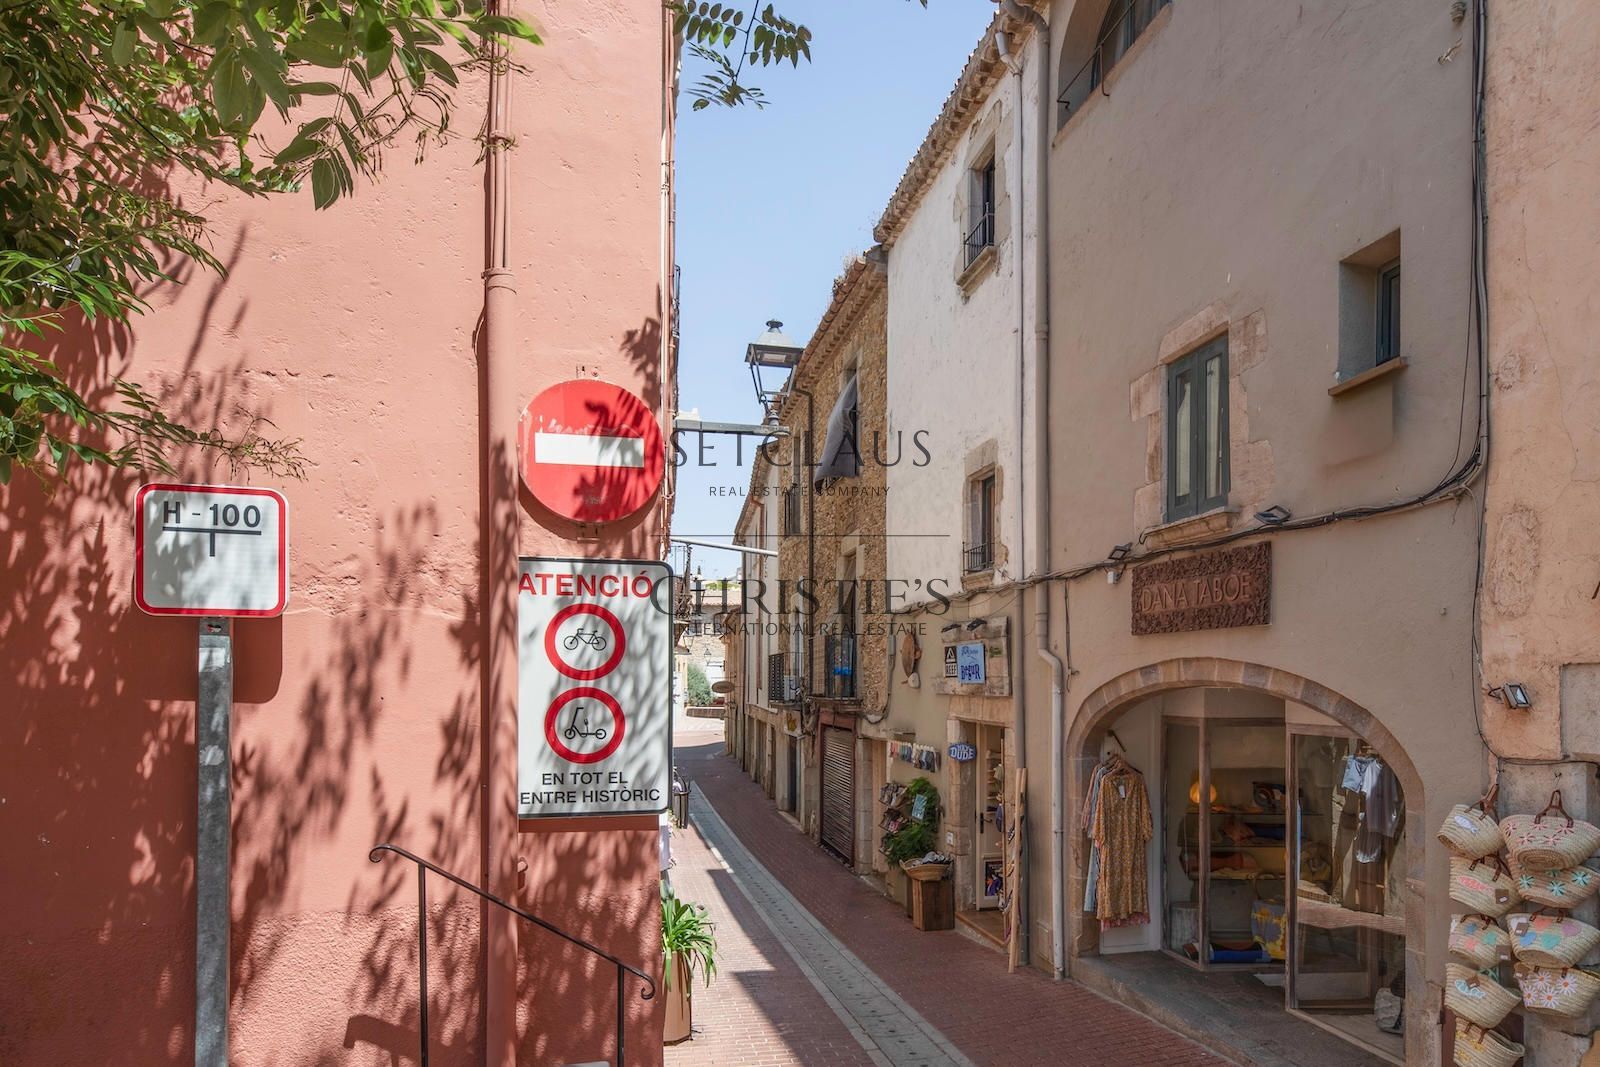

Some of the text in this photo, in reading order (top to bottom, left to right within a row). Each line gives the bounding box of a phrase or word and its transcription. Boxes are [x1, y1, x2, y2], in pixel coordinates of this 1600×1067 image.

[518, 570, 653, 598] ATENCIÓ
[1140, 571, 1252, 616] DANA TABOE
[950, 746, 974, 761] DUDE
[542, 771, 628, 786] EN TOT EL
[519, 786, 661, 805] ENTRE HISTÒRIC
